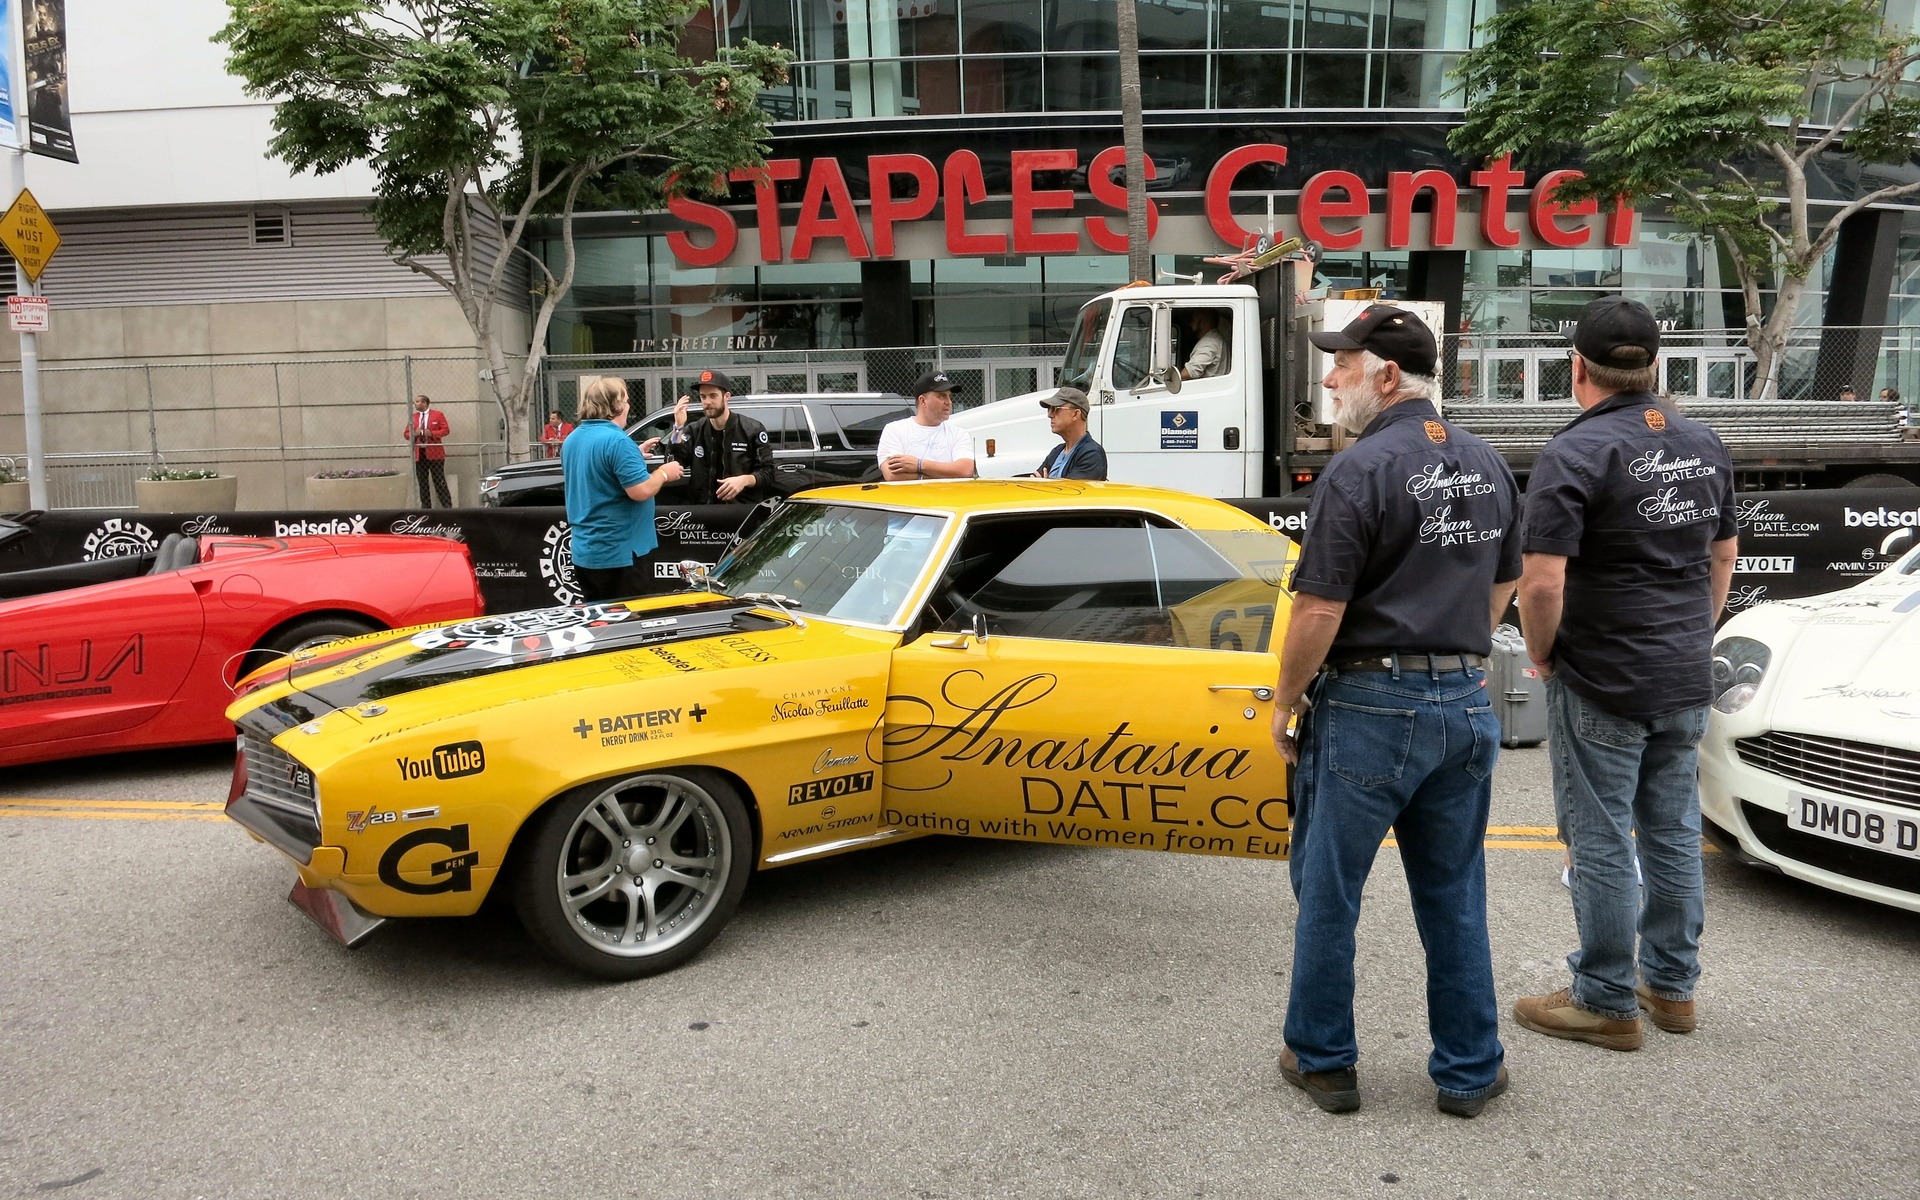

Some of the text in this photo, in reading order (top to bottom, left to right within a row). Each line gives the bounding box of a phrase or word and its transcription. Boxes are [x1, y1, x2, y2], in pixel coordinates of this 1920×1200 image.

[18, 202, 37, 214] RIGHT
[665, 145, 1159, 267] STAPLES
[20, 216, 38, 228] LANE
[16, 228, 43, 242] MUST
[23, 244, 40, 255] TURN
[23, 256, 41, 268] RIGHT
[10, 303, 47, 313] NO STOPPING
[661, 336, 718, 351] STREET
[727, 334, 778, 349] ENTRY
[1103, 393, 1115, 404] 26
[1628, 449, 1716, 483] Anastasia DATE.COM
[1637, 486, 1718, 525] Asian DATE.CO
[1735, 499, 1820, 532] Asian DATE.COM
[181, 515, 231, 537] Asian
[390, 514, 462, 535] Anastasia
[653, 511, 735, 541] Asian DATE.COM
[1441, 529, 1502, 547] DATE.COM
[1735, 558, 1793, 571] EVOLT
[1826, 562, 1895, 571] ARMIN STR
[1210, 604, 1274, 654] 67
[721, 637, 777, 663] GUESS
[783, 685, 853, 700] CHAMPAGNE
[599, 707, 682, 733] BATTERY
[771, 697, 870, 722] Nicolas Feuillatte
[601, 731, 649, 747] ENERGY DRINK
[866, 669, 1252, 791] Anastasia
[396, 748, 483, 781] YouTube
[790, 772, 872, 804] REVOLT
[347, 805, 398, 834] Z/28
[775, 813, 874, 841] ARMIN STROM
[1801, 797, 1885, 844] DM08
[886, 809, 970, 836] Dating
[980, 818, 1038, 837] with
[1048, 821, 1156, 847] Women
[1162, 829, 1241, 854] from
[445, 858, 465, 870] PEN
